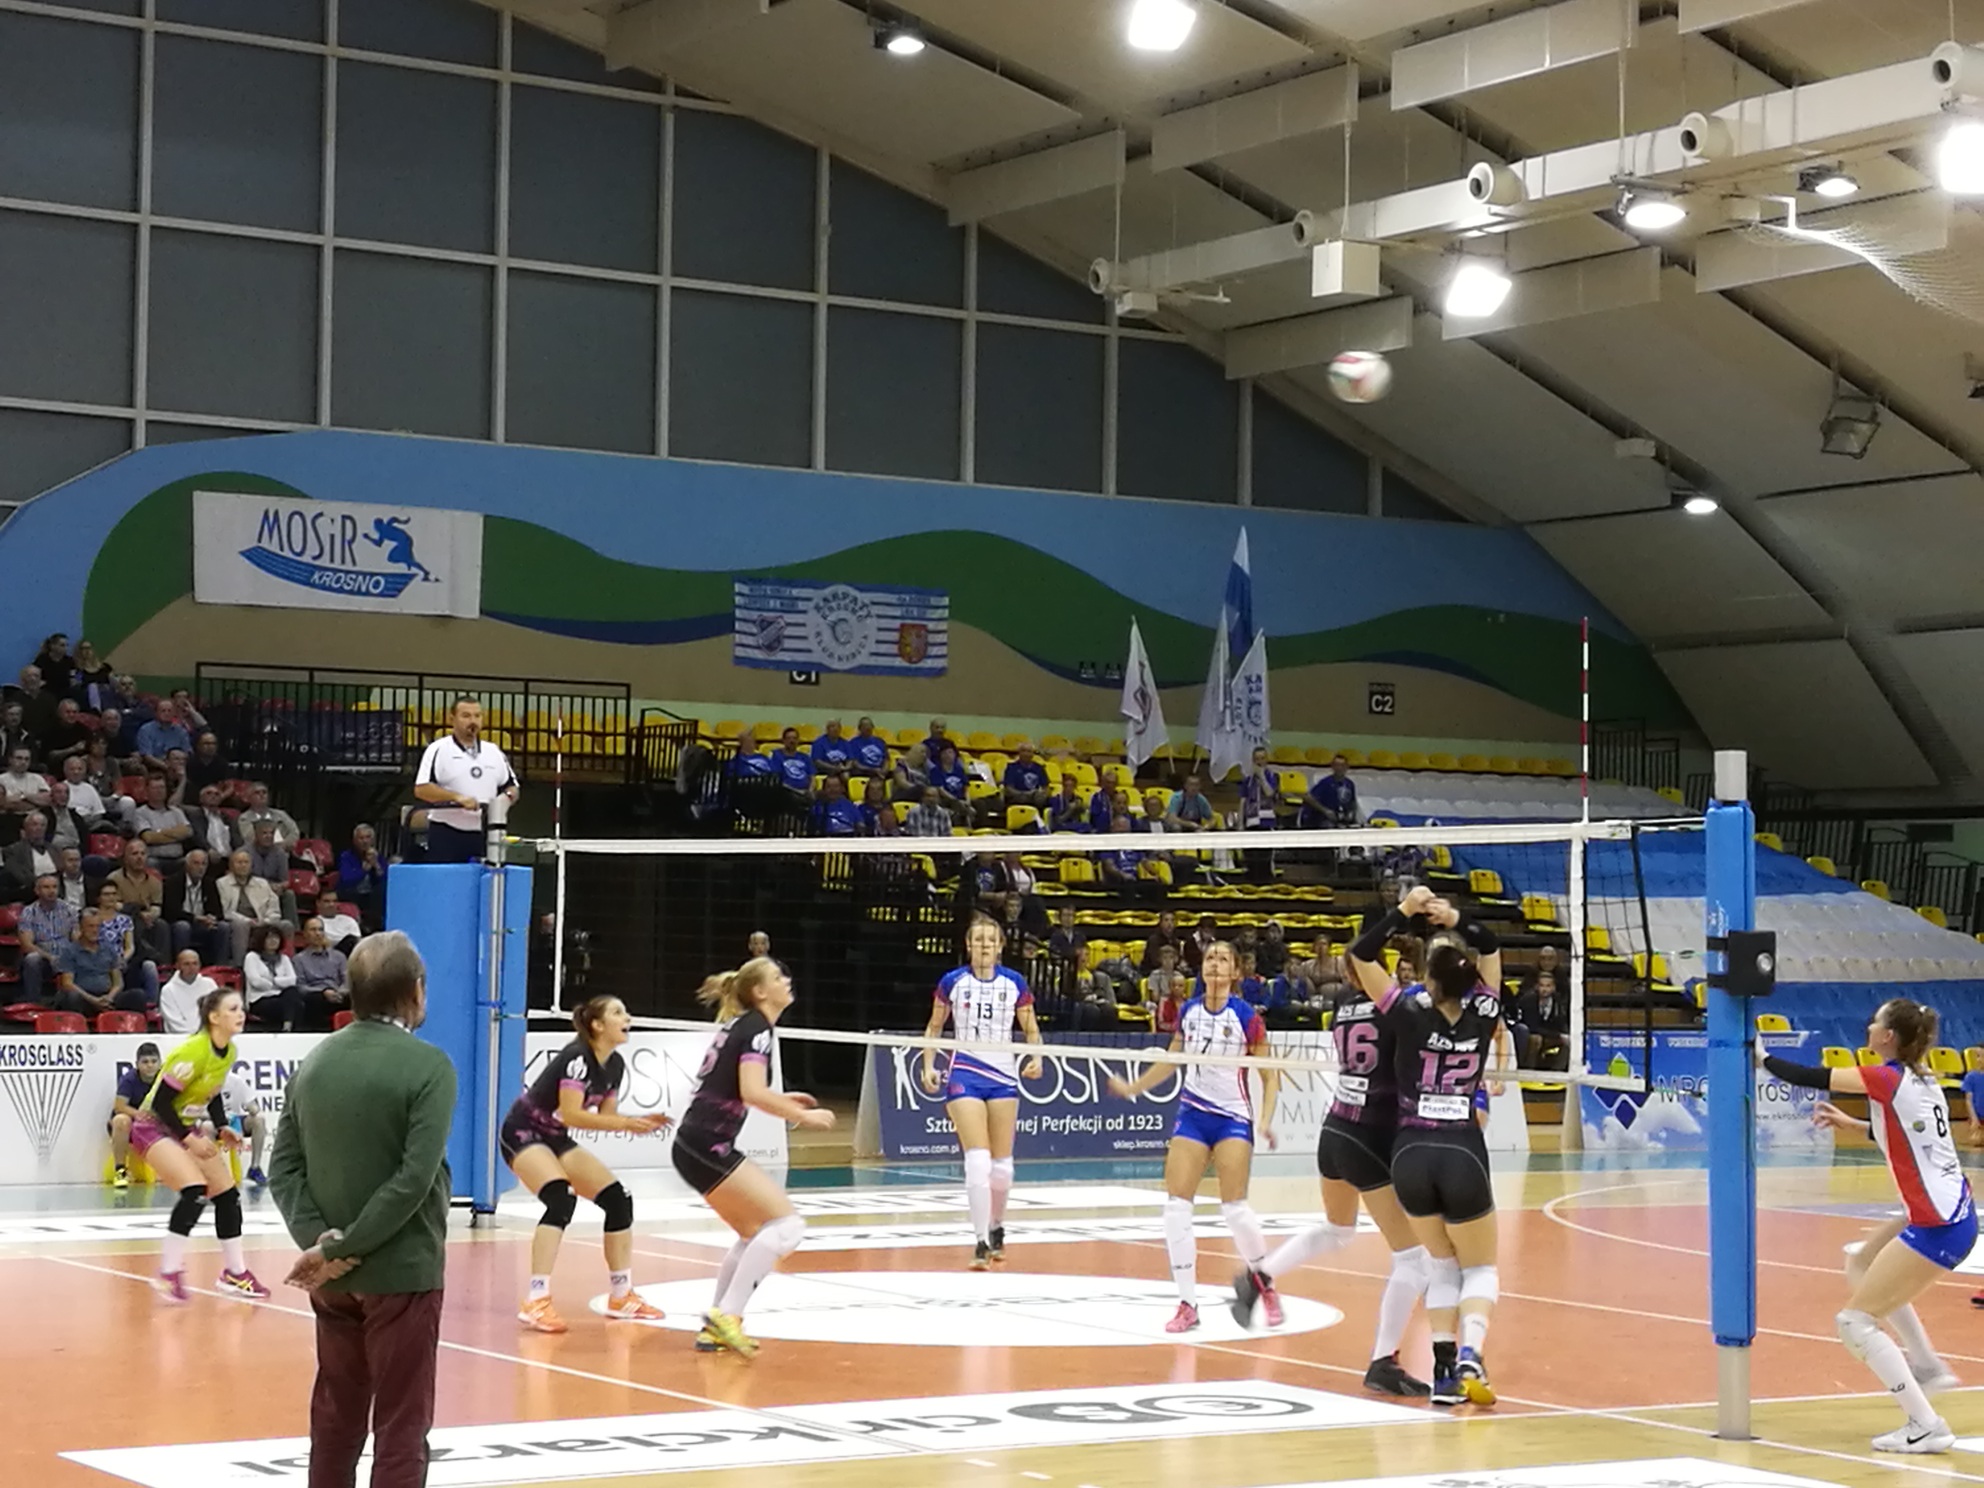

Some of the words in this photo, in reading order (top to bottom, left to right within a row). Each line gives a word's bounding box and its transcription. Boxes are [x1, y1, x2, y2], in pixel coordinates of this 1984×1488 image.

[257, 508, 357, 566] MOSiR
[310, 569, 385, 594] KROSNO
[1371, 694, 1393, 712] C2
[976, 1002, 993, 1019] 13
[0, 1044, 83, 1066] KROSGLASS
[1203, 1037, 1212, 1054] 7
[1333, 1022, 1378, 1074] 16
[1418, 1050, 1480, 1094] 12
[1042, 1115, 1101, 1135] Perfekcji
[1105, 1115, 1124, 1131] od
[1128, 1114, 1164, 1131] 1923
[1933, 1105, 1947, 1138] 8
[1113, 1139, 1171, 1151] sklep.krosno.c
